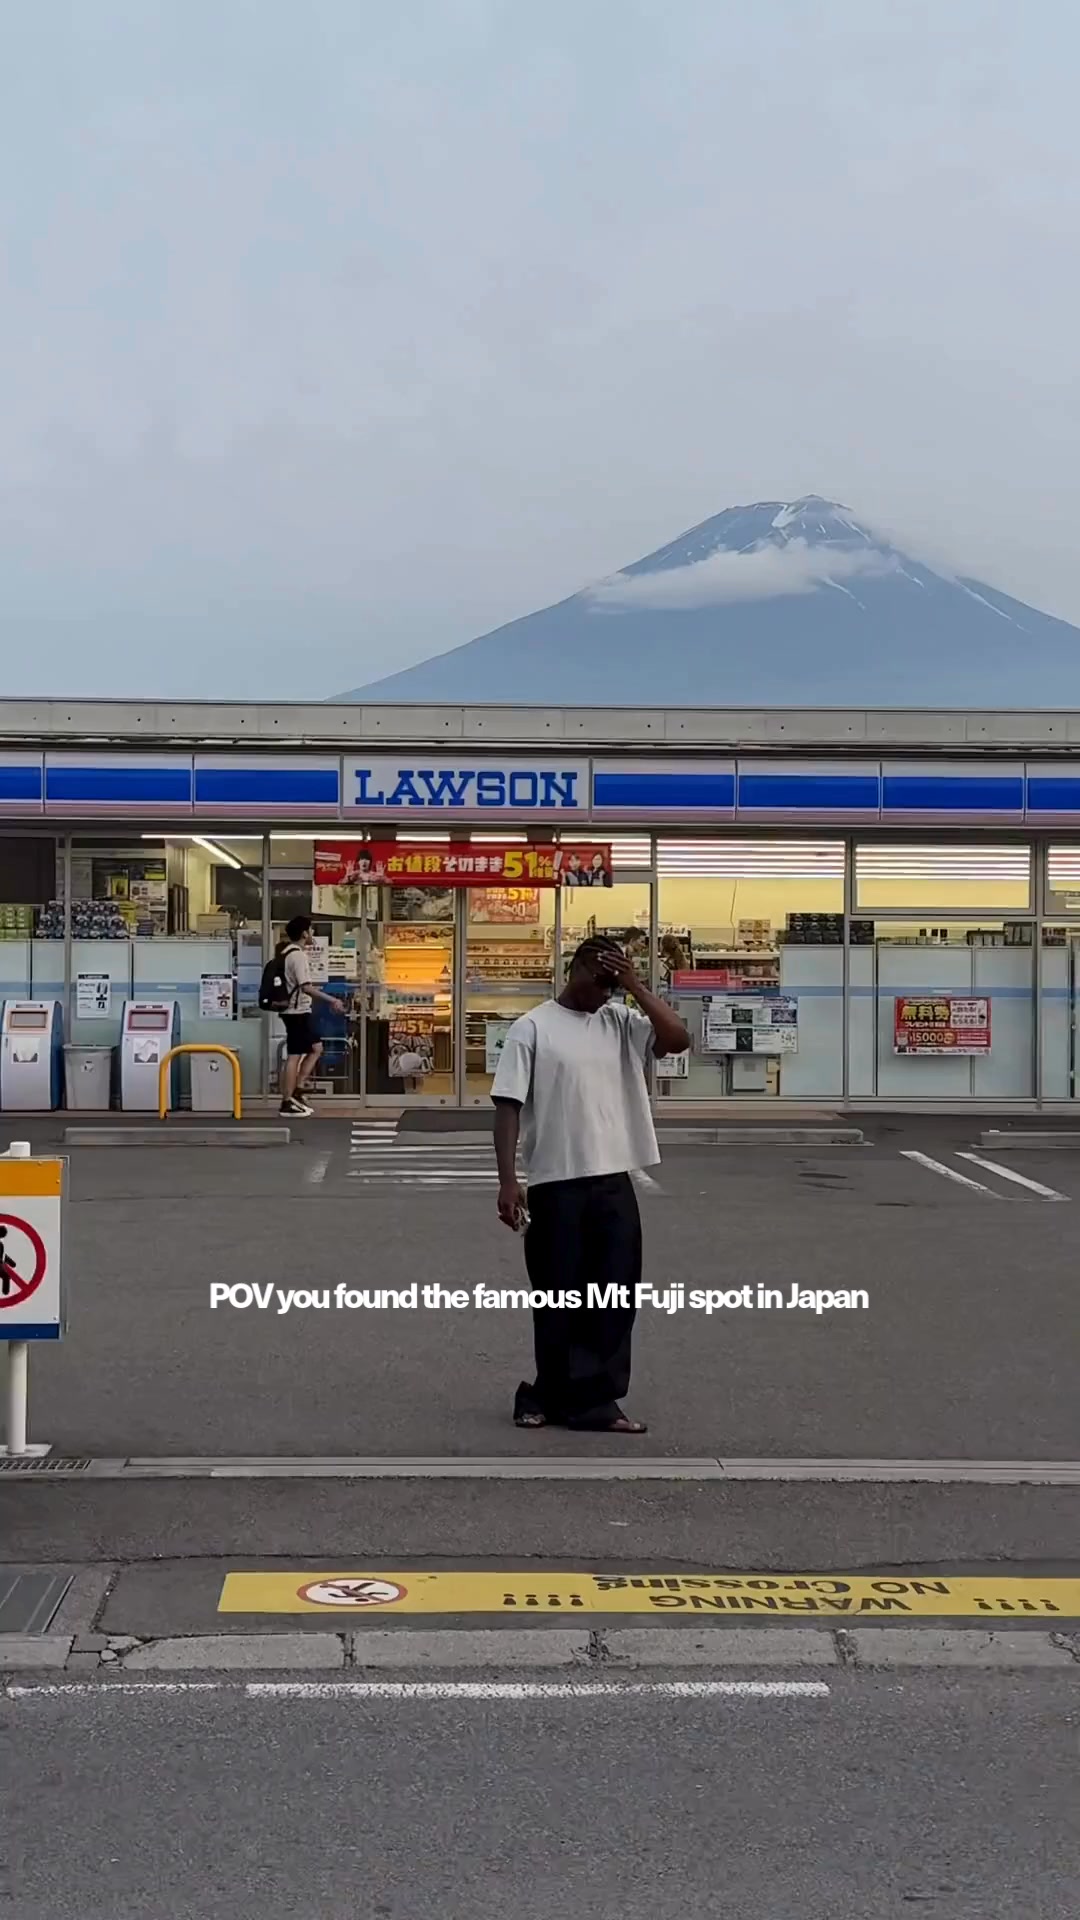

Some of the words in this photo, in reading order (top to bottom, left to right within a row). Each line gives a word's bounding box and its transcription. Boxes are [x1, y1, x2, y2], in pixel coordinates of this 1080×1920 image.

[355, 769, 577, 806] LAWSON
[592, 1576, 851, 1594] Crossing
[871, 1581, 951, 1595] NO
[649, 1595, 912, 1611] WARNING
